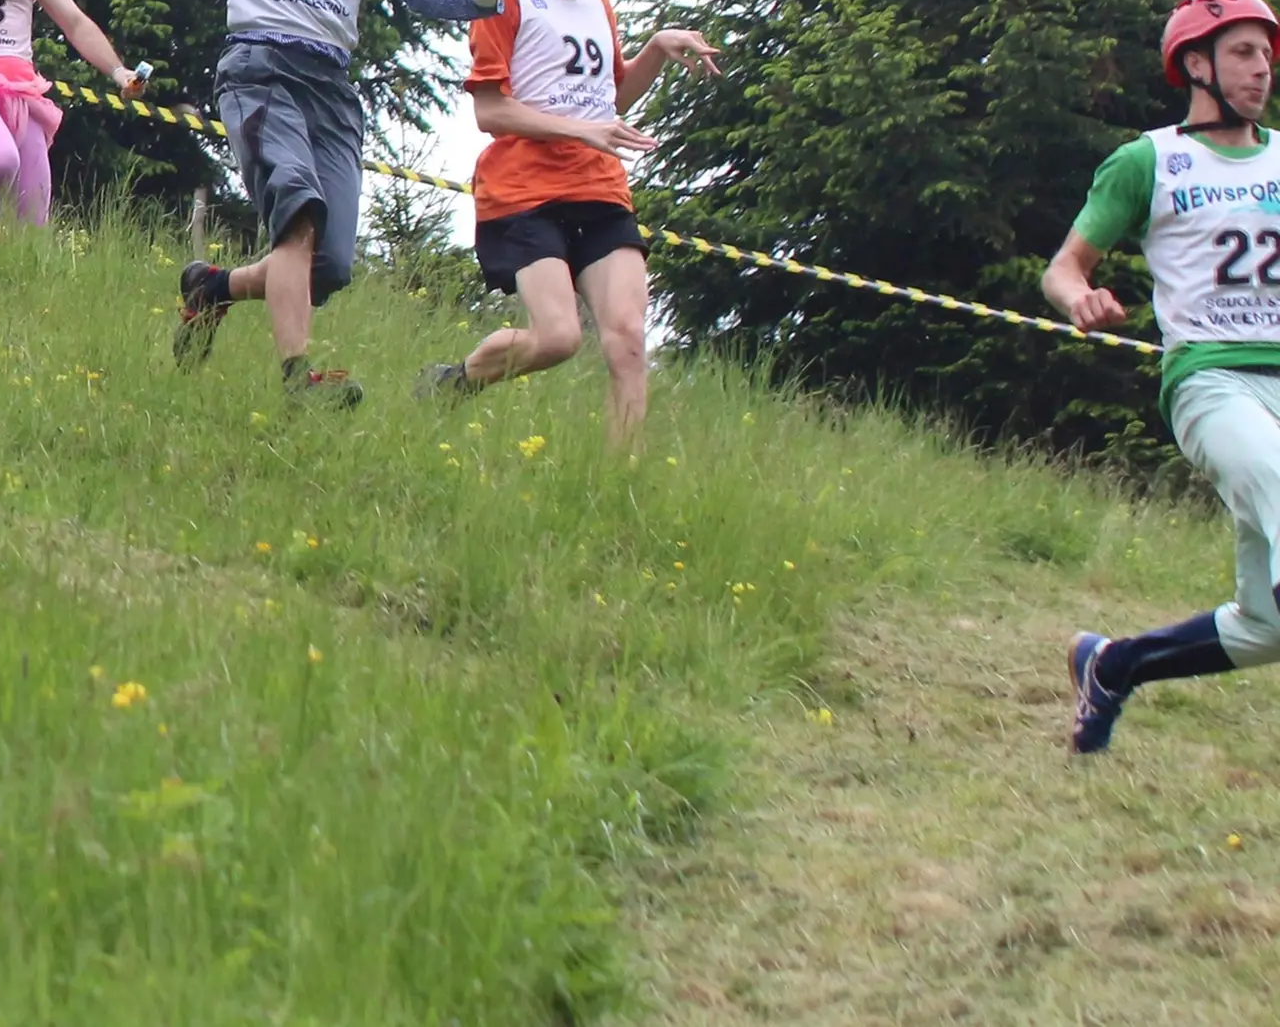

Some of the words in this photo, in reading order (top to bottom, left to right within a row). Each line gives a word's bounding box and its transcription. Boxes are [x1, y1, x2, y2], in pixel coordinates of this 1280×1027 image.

[562, 35, 603, 78] 29
[1171, 179, 1280, 215] NEWSPOR
[1213, 229, 1280, 286] 22
[1205, 296, 1262, 309] SCUOLA
